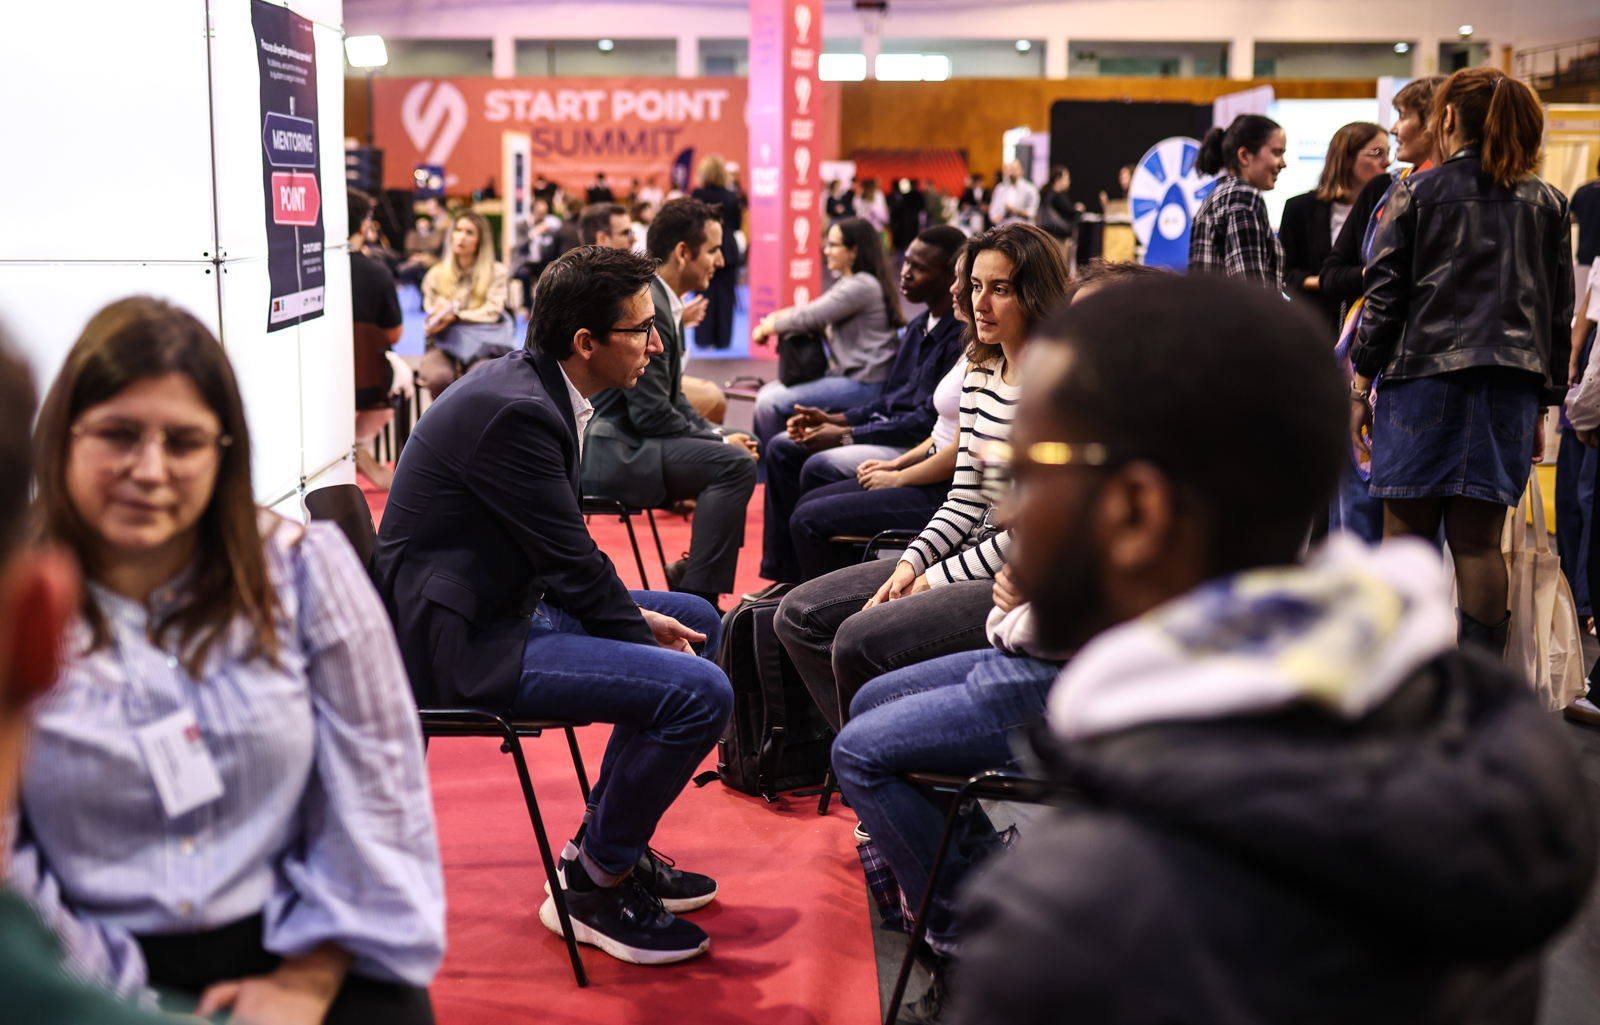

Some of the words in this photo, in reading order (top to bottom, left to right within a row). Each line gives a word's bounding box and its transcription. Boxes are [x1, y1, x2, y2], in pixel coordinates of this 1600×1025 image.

[484, 89, 607, 122] START
[611, 89, 729, 122] POINT
[272, 129, 313, 153] MENTORING
[531, 126, 683, 157] SUMMIT
[280, 186, 306, 212] POINT
